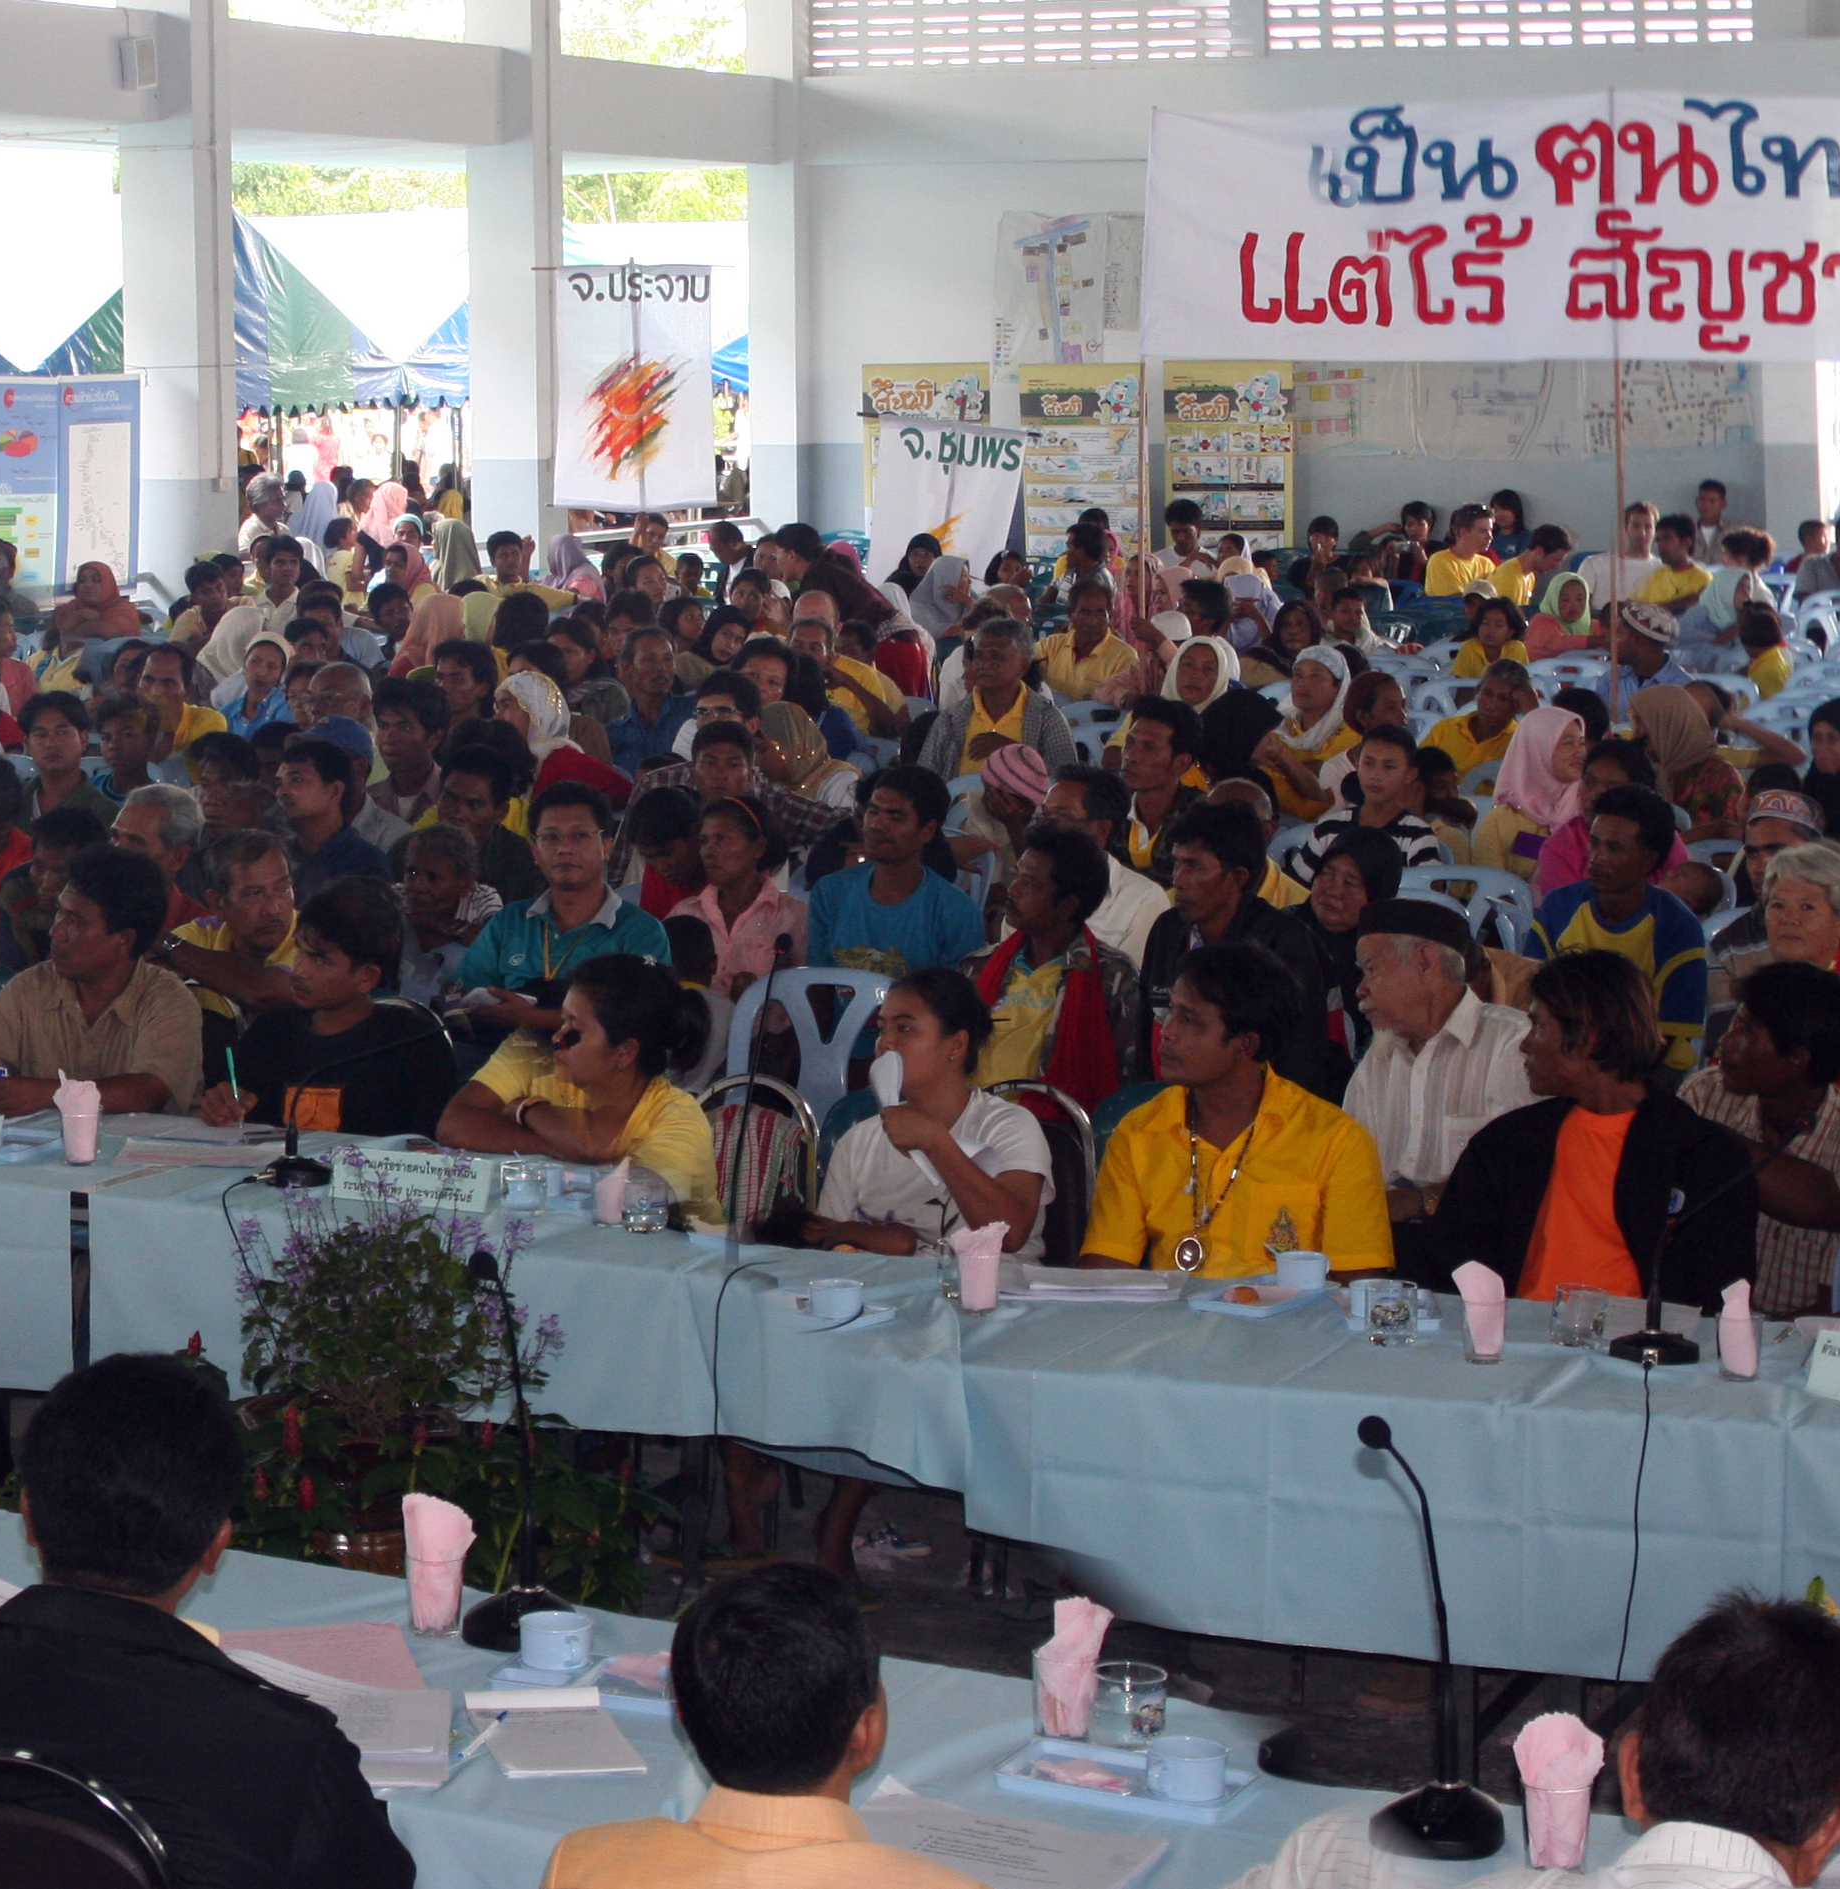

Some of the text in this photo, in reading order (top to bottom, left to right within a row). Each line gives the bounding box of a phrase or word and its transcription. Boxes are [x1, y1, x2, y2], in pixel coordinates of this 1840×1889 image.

[1309, 104, 1518, 206] เป็น
[568, 266, 711, 303] จ.ประจวบ
[1240, 212, 1534, 327] แต่ไร้
[900, 426, 1023, 474] จ.ชุมพร
